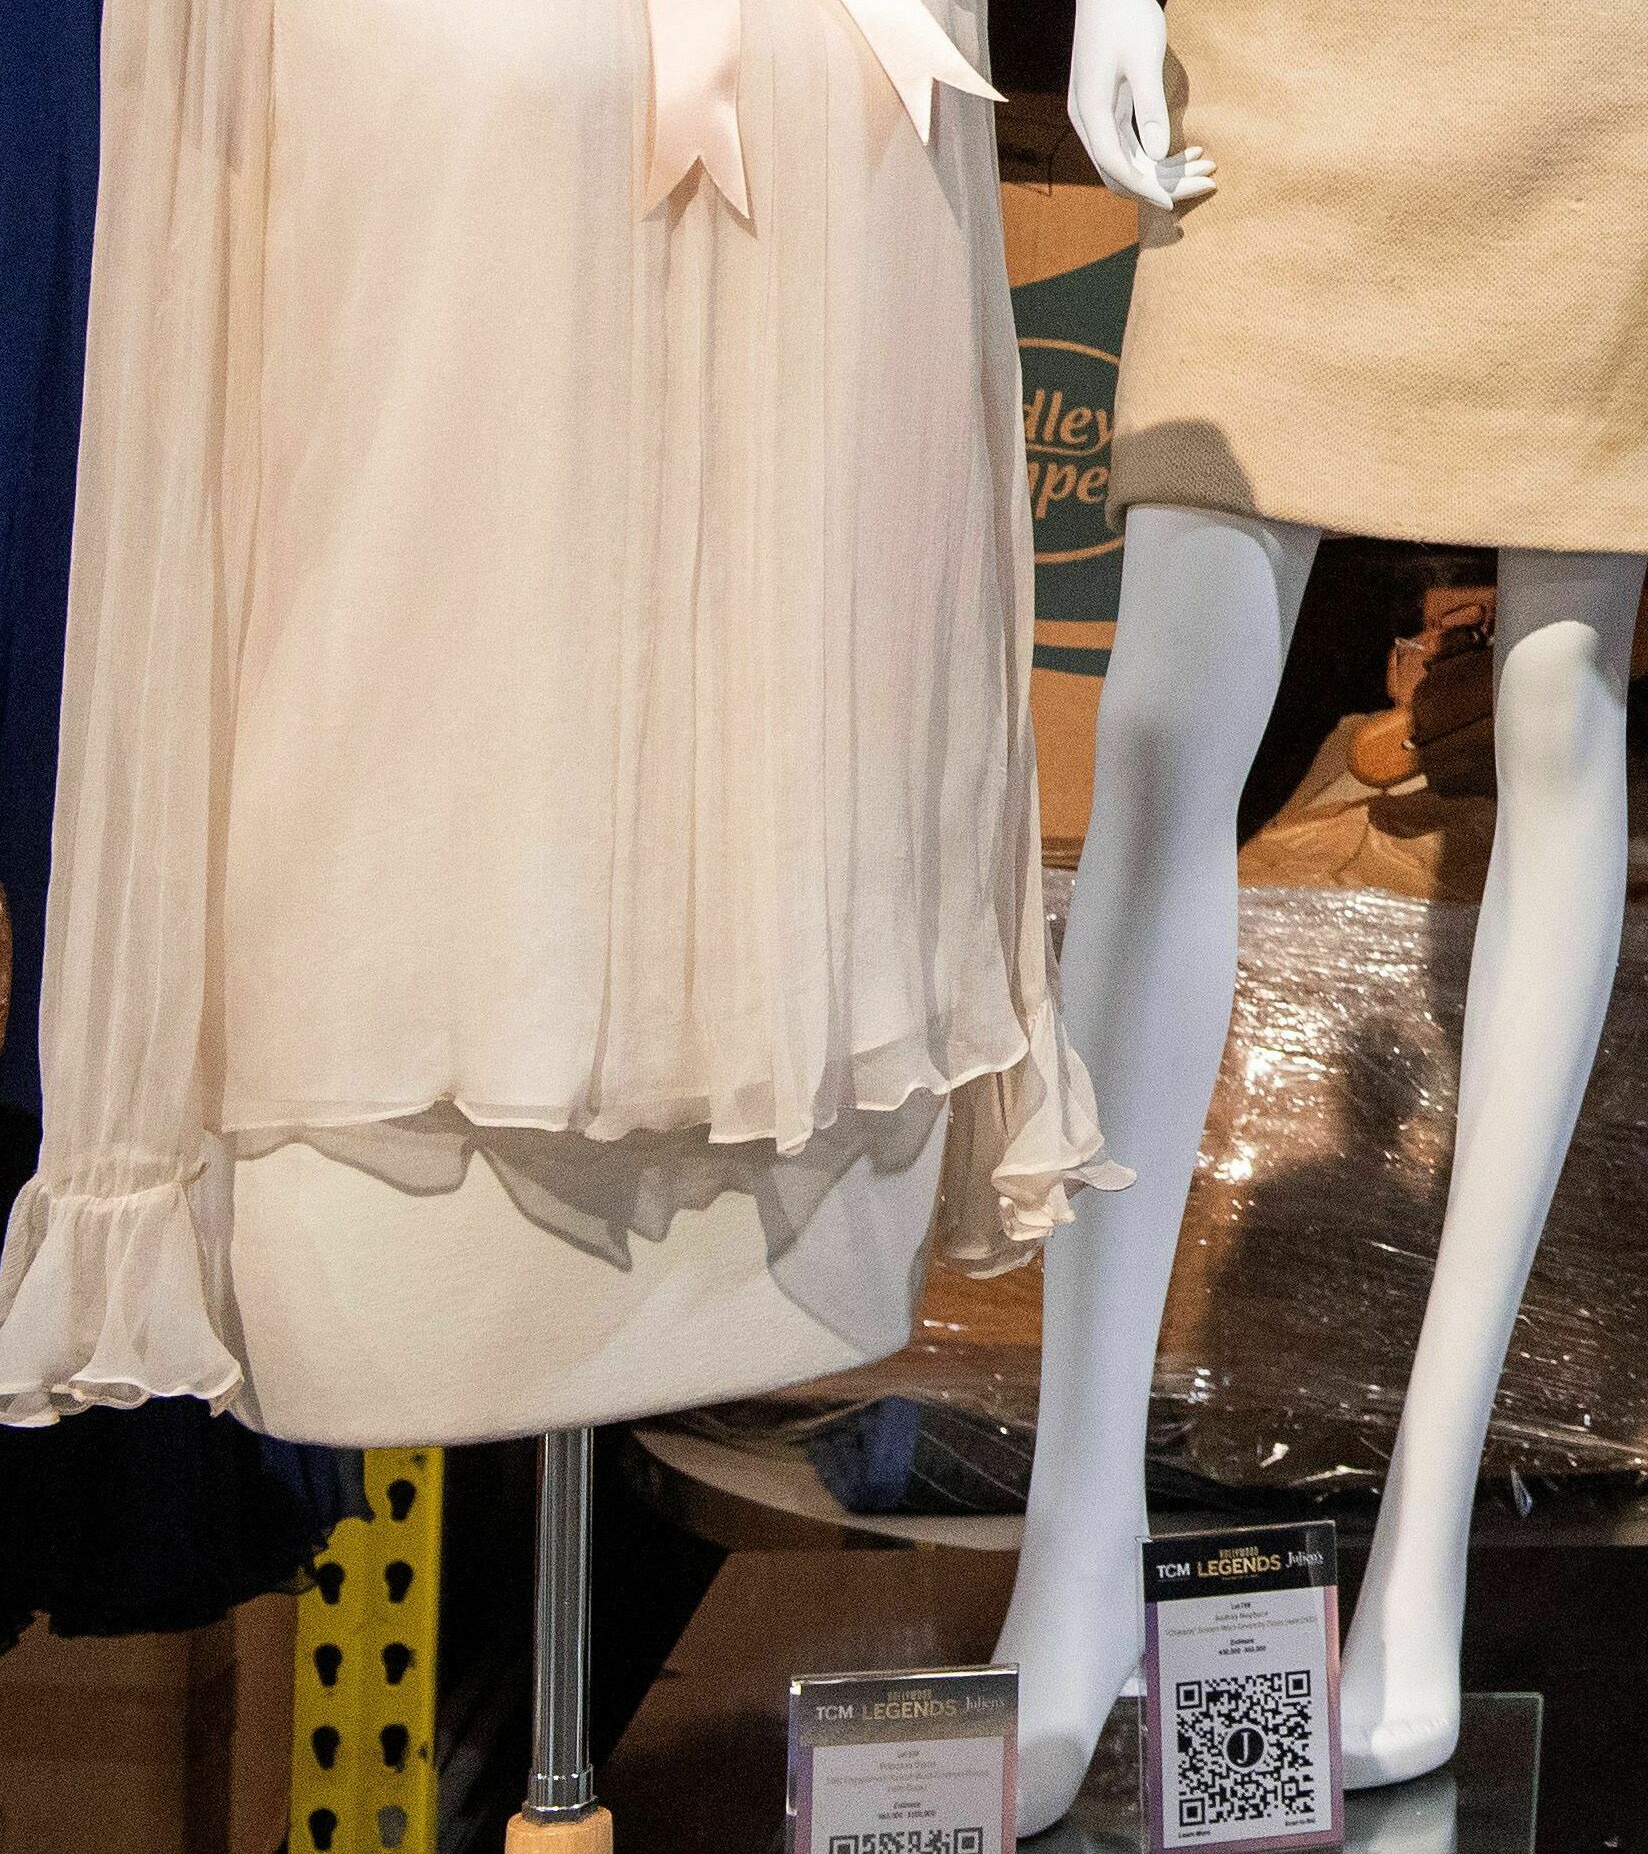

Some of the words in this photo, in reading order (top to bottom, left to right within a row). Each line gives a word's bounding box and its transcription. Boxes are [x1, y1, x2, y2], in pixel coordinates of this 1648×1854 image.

[1156, 1562, 1190, 1578] TCM
[1196, 1554, 1282, 1578] LEGENDS
[816, 1704, 854, 1721] TCM
[862, 1698, 957, 1721] LEGENDS
[1236, 1732, 1251, 1764] J
